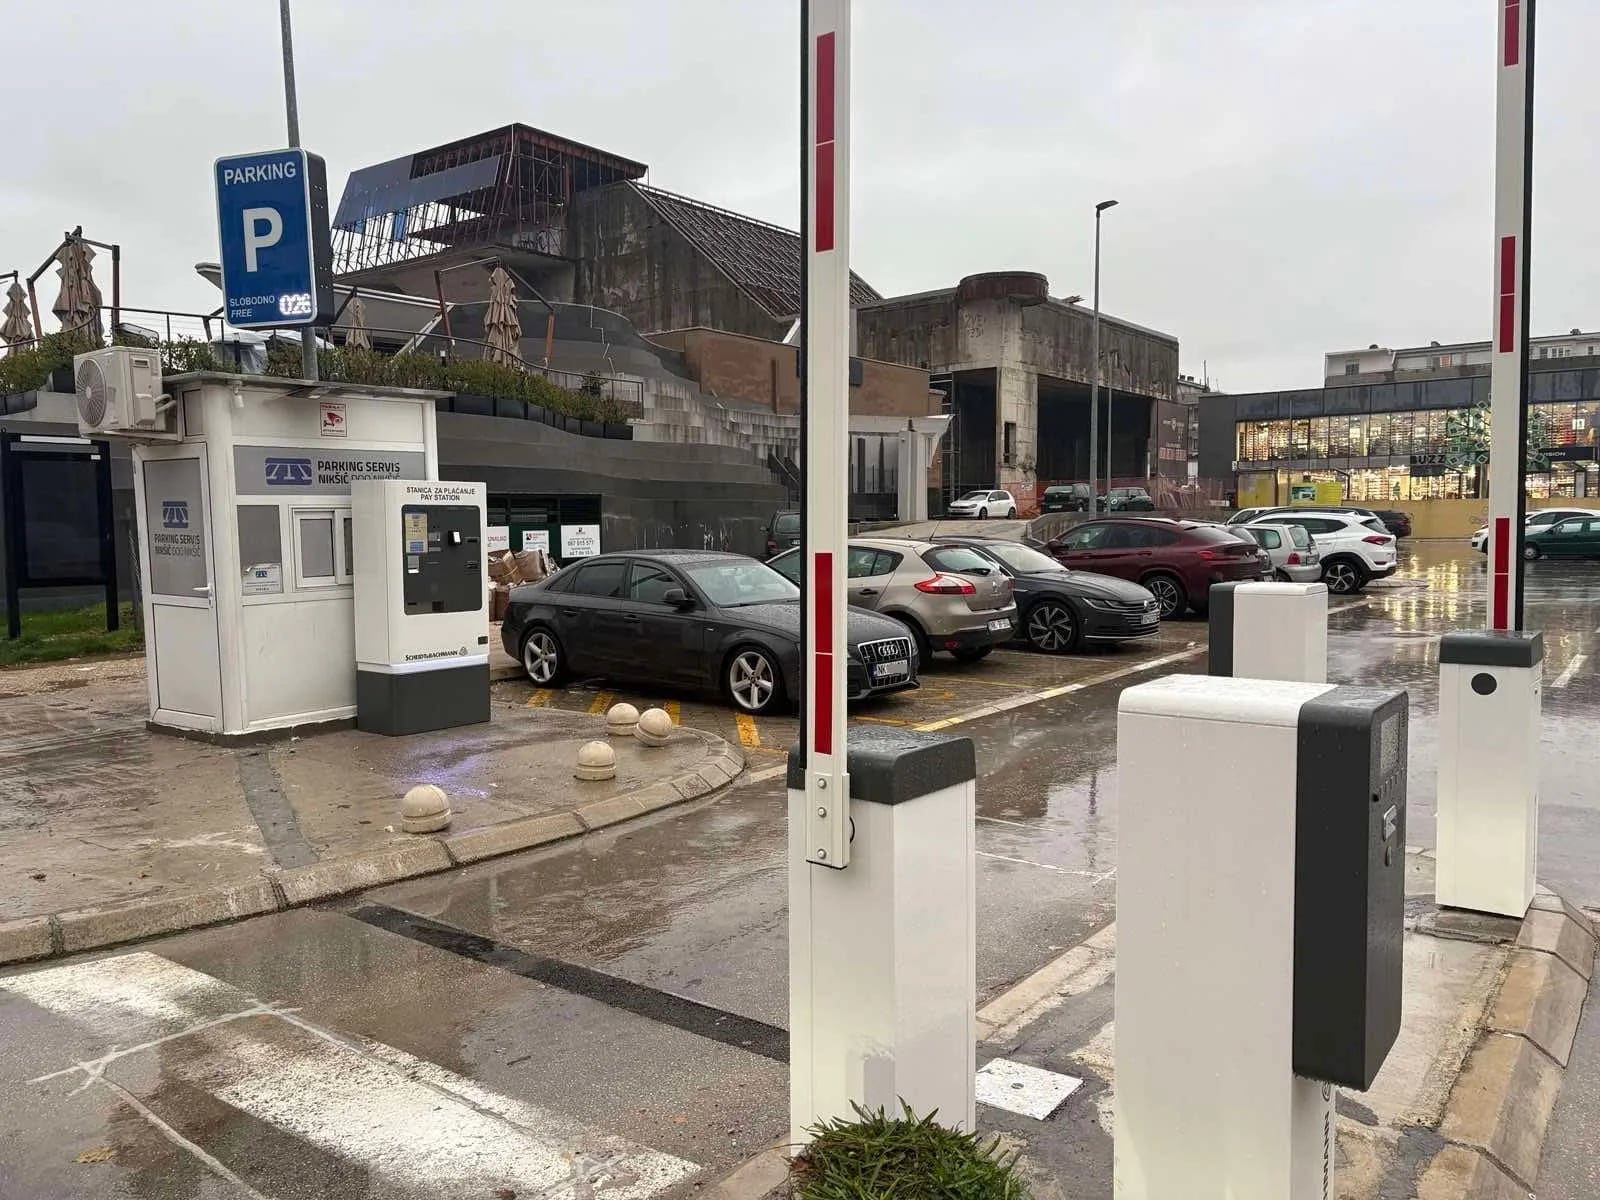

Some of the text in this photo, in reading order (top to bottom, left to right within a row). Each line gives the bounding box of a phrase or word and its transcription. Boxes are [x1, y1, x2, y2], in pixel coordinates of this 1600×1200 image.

[224, 161, 296, 185] PARKING
[242, 207, 283, 272] P
[229, 295, 275, 307] SLOBODNO
[231, 309, 253, 318] FREE
[317, 460, 400, 473] PARKING SERVIS
[318, 471, 349, 485] NIKŠIĆ
[406, 486, 432, 494] STANICA
[420, 493, 433, 501] PAY
[154, 533, 200, 545] PARKING SERVIS
